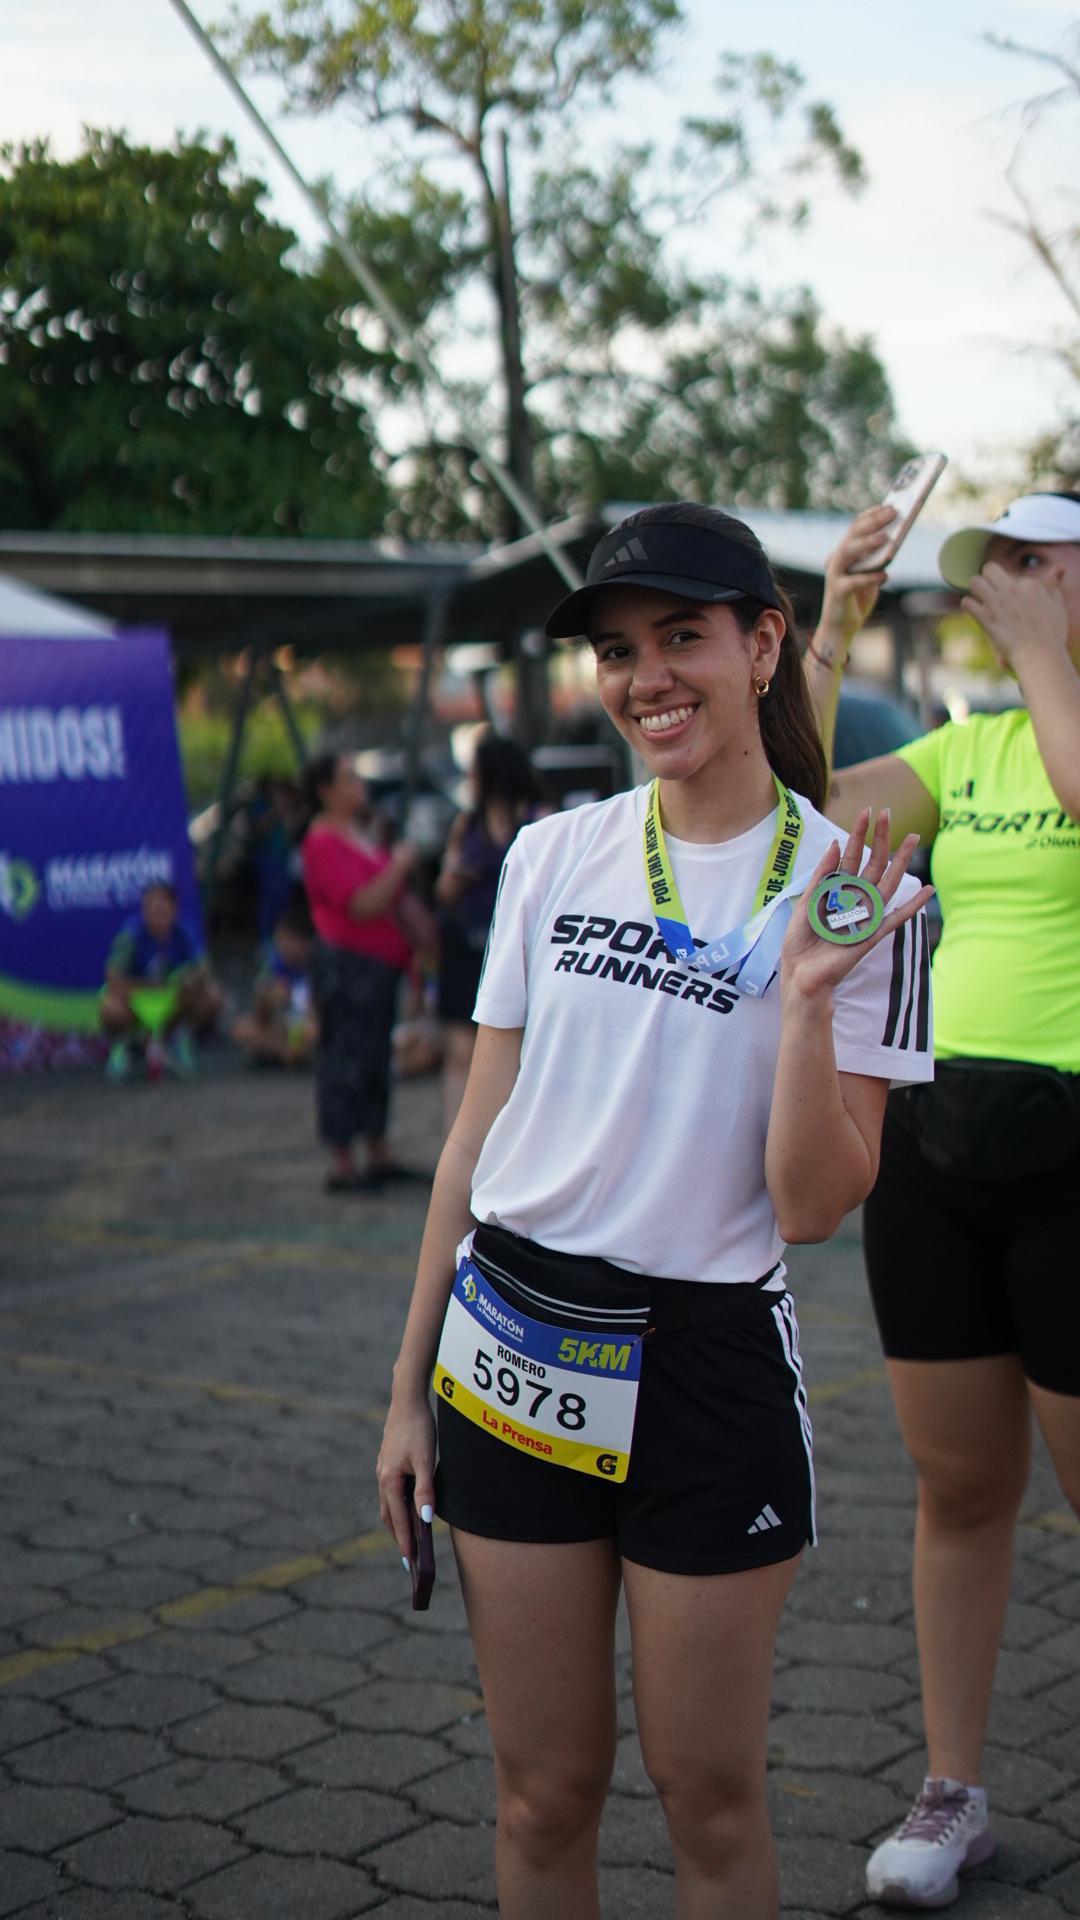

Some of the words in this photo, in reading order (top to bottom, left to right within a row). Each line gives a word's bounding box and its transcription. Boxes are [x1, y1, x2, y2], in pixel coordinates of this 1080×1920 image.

[784, 821, 801, 838] DE
[648, 853, 664, 880] UNA
[772, 840, 795, 876] JUNIO
[652, 878, 672, 905] POR
[767, 878, 785, 893] DE
[554, 950, 740, 1014] RUNNERS
[478, 1293, 524, 1338] MARATÓN
[497, 1345, 546, 1379] ROMERO
[557, 1337, 632, 1371] 5KM
[473, 1348, 587, 1430] 5978
[482, 1409, 499, 1430] La
[502, 1422, 553, 1455] Prensa
